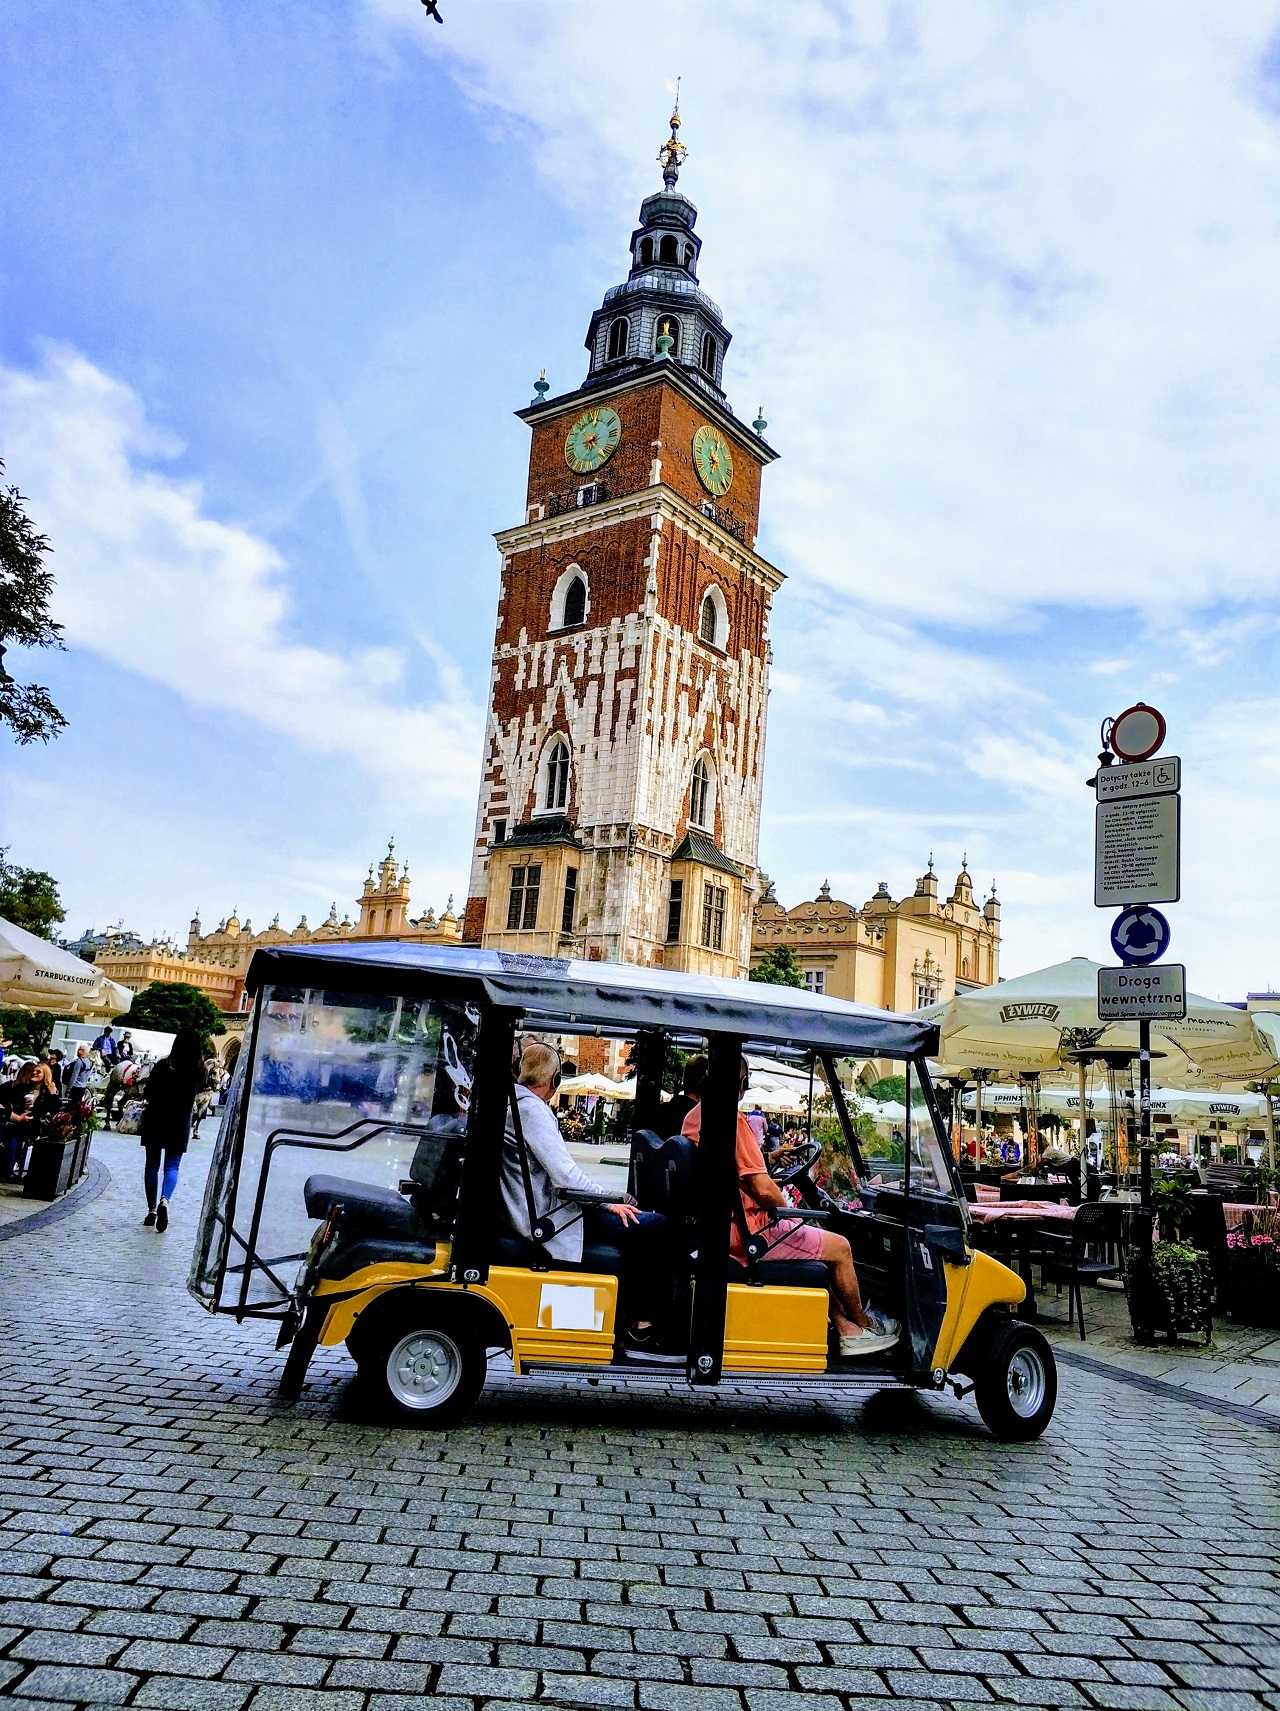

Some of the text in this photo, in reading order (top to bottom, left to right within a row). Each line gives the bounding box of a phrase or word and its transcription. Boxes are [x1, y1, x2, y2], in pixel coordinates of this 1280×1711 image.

[1100, 770, 1151, 783] Dotyczy także
[1110, 783, 1130, 792] godz.
[1132, 779, 1149, 788] 12-6
[35, 970, 95, 987] STARBUCKS COFFEE
[1118, 976, 1160, 989] Droga
[1101, 993, 1182, 1007] wewnętrzna
[1008, 1004, 1054, 1016] ŻYWIEC
[1187, 1018, 1237, 1028] mamma
